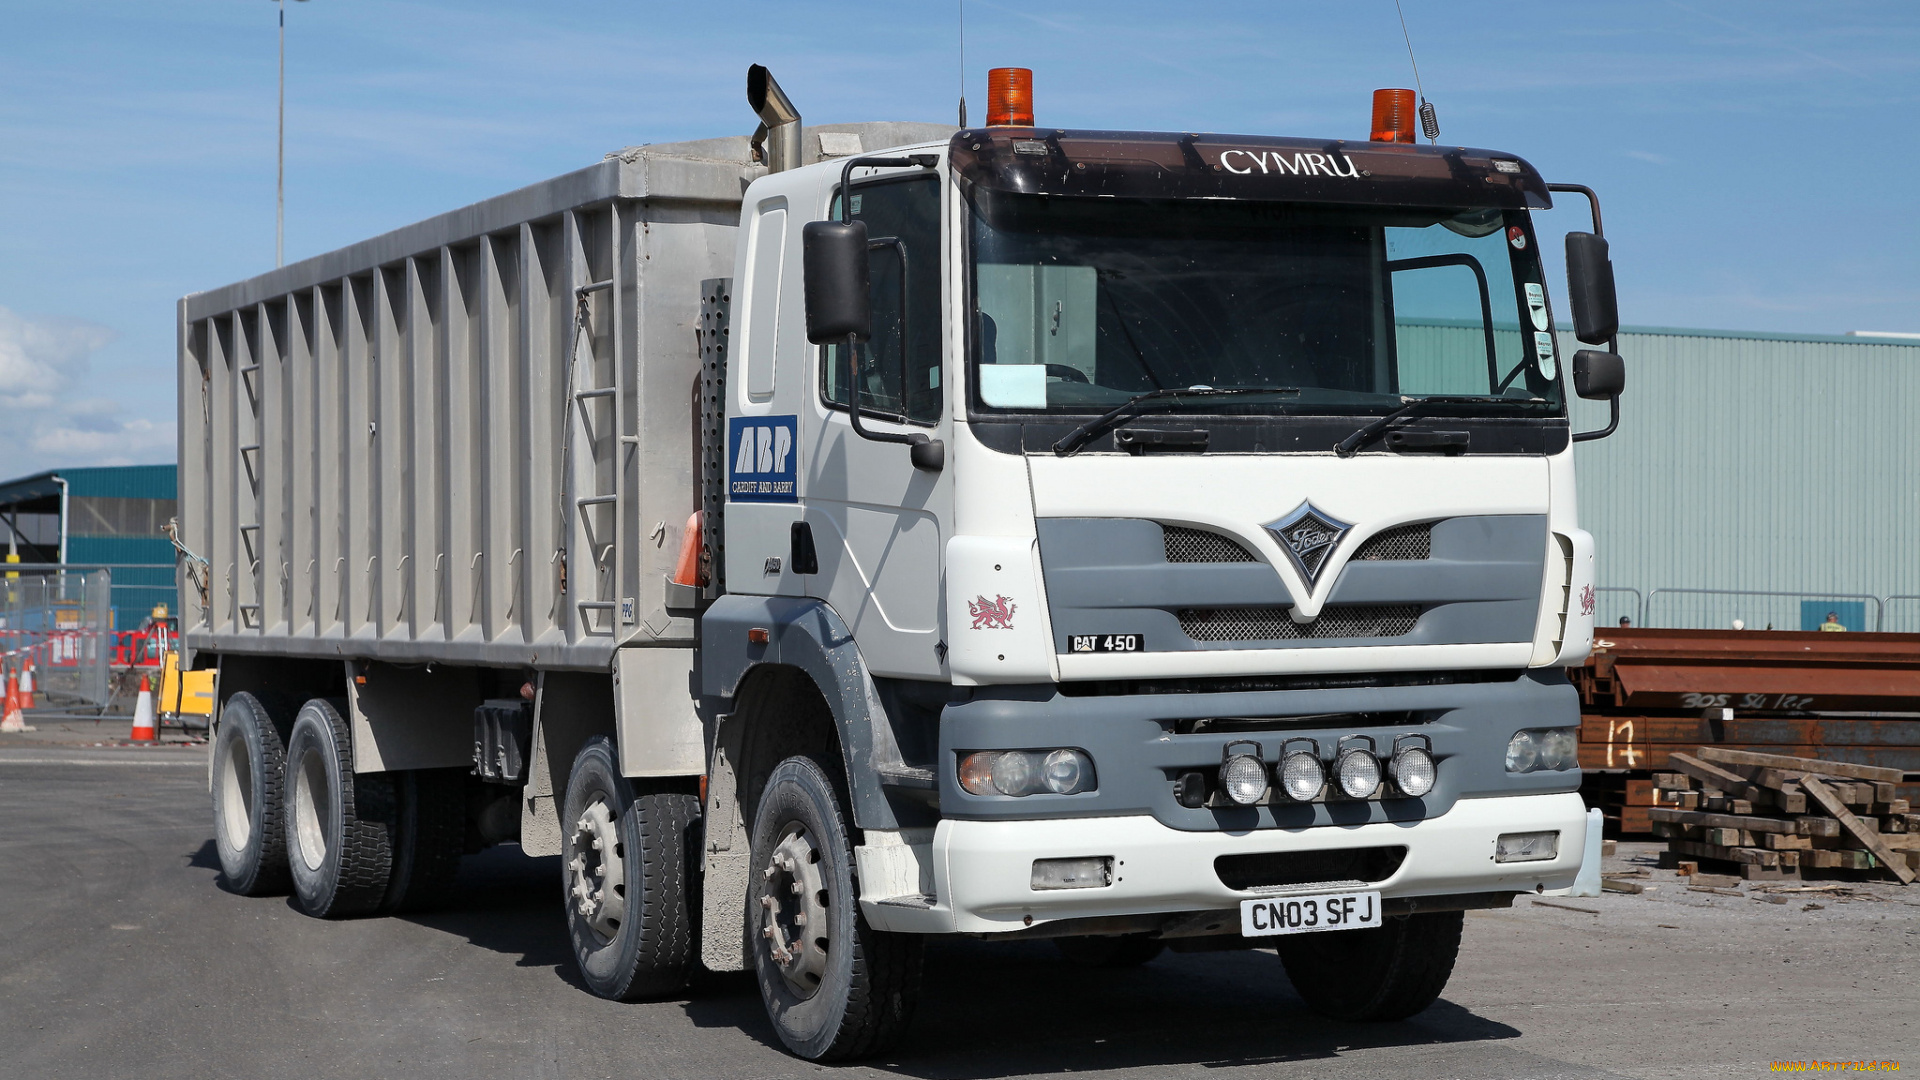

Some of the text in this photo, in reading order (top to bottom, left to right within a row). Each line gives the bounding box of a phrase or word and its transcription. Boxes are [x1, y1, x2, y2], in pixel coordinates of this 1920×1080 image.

[1220, 150, 1361, 178] CYMRU
[734, 426, 792, 474] ABP
[732, 481, 794, 493] CARDIFF AND BARRY
[1073, 635, 1137, 652] CAT 450
[1252, 895, 1373, 930] CN03 SFJ
